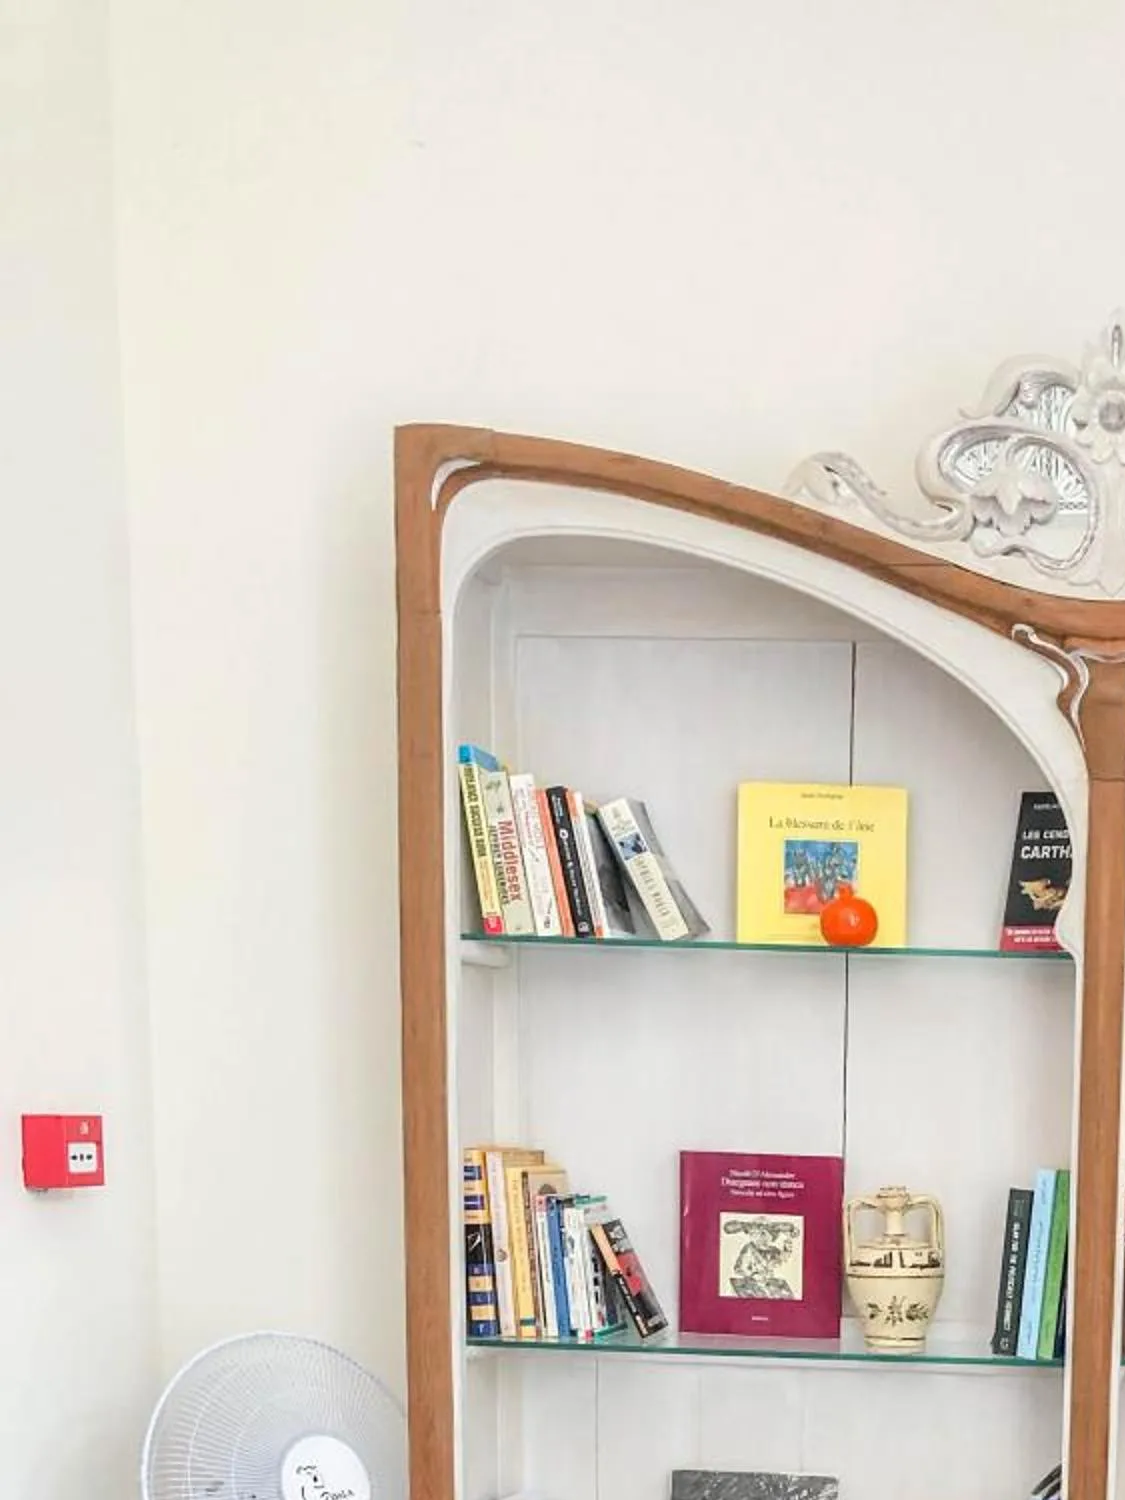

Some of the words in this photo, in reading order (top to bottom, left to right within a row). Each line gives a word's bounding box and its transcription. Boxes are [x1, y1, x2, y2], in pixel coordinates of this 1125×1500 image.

[768, 815, 783, 829] La
[1043, 829, 1071, 839] CEND
[1021, 845, 1073, 859] CARTH
[497, 819, 526, 902] Middlesex
